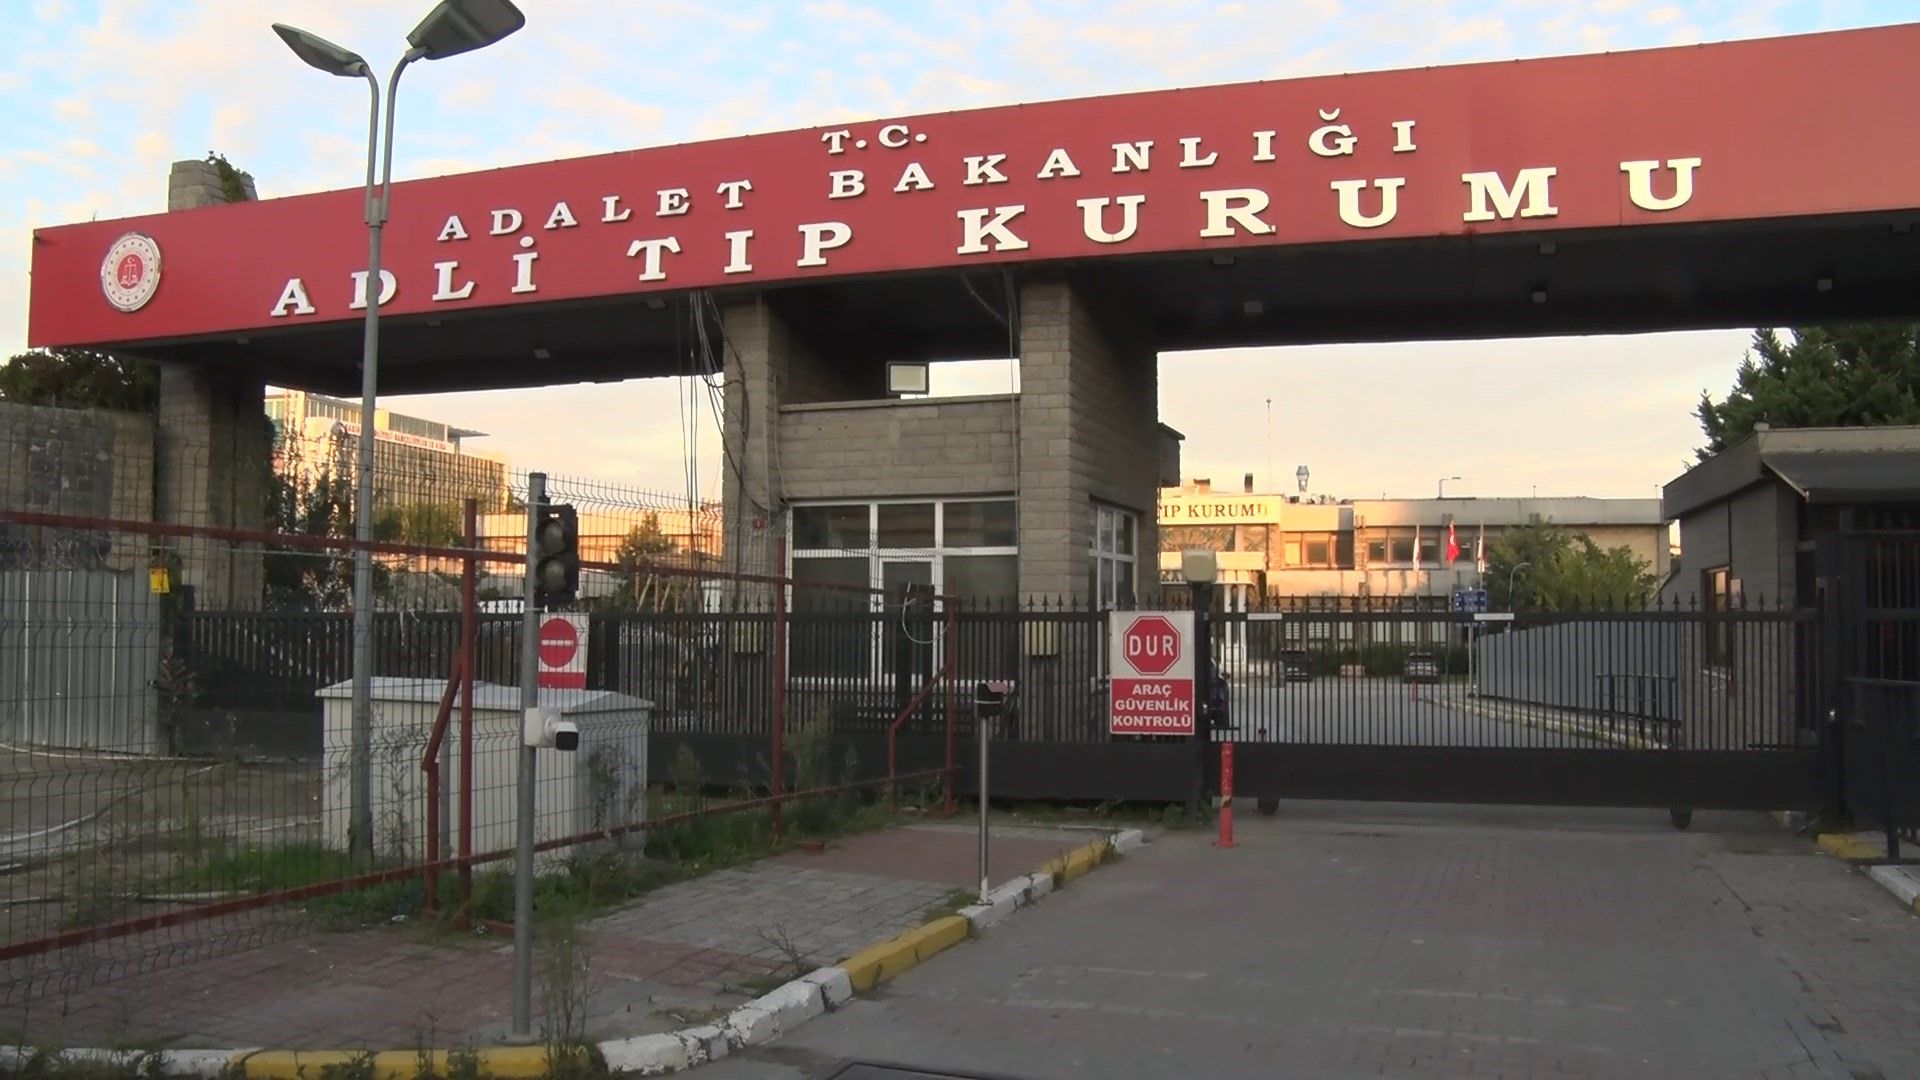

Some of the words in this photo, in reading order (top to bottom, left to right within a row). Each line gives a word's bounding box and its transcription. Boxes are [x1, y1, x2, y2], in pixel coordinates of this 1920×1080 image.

[820, 124, 928, 154] T.C.
[437, 179, 753, 242] ADALET
[828, 107, 1418, 200] BAKANLIĞI
[270, 235, 539, 317] ADLİ
[626, 221, 853, 282] TIP
[956, 156, 1702, 256] KURUMU
[1159, 503, 1181, 518] IP
[1128, 634, 1175, 657] DUR
[1132, 683, 1172, 697] ARAÇ
[1114, 697, 1190, 712] GÜVENLİK
[1113, 713, 1192, 728] KONTROLÜ
